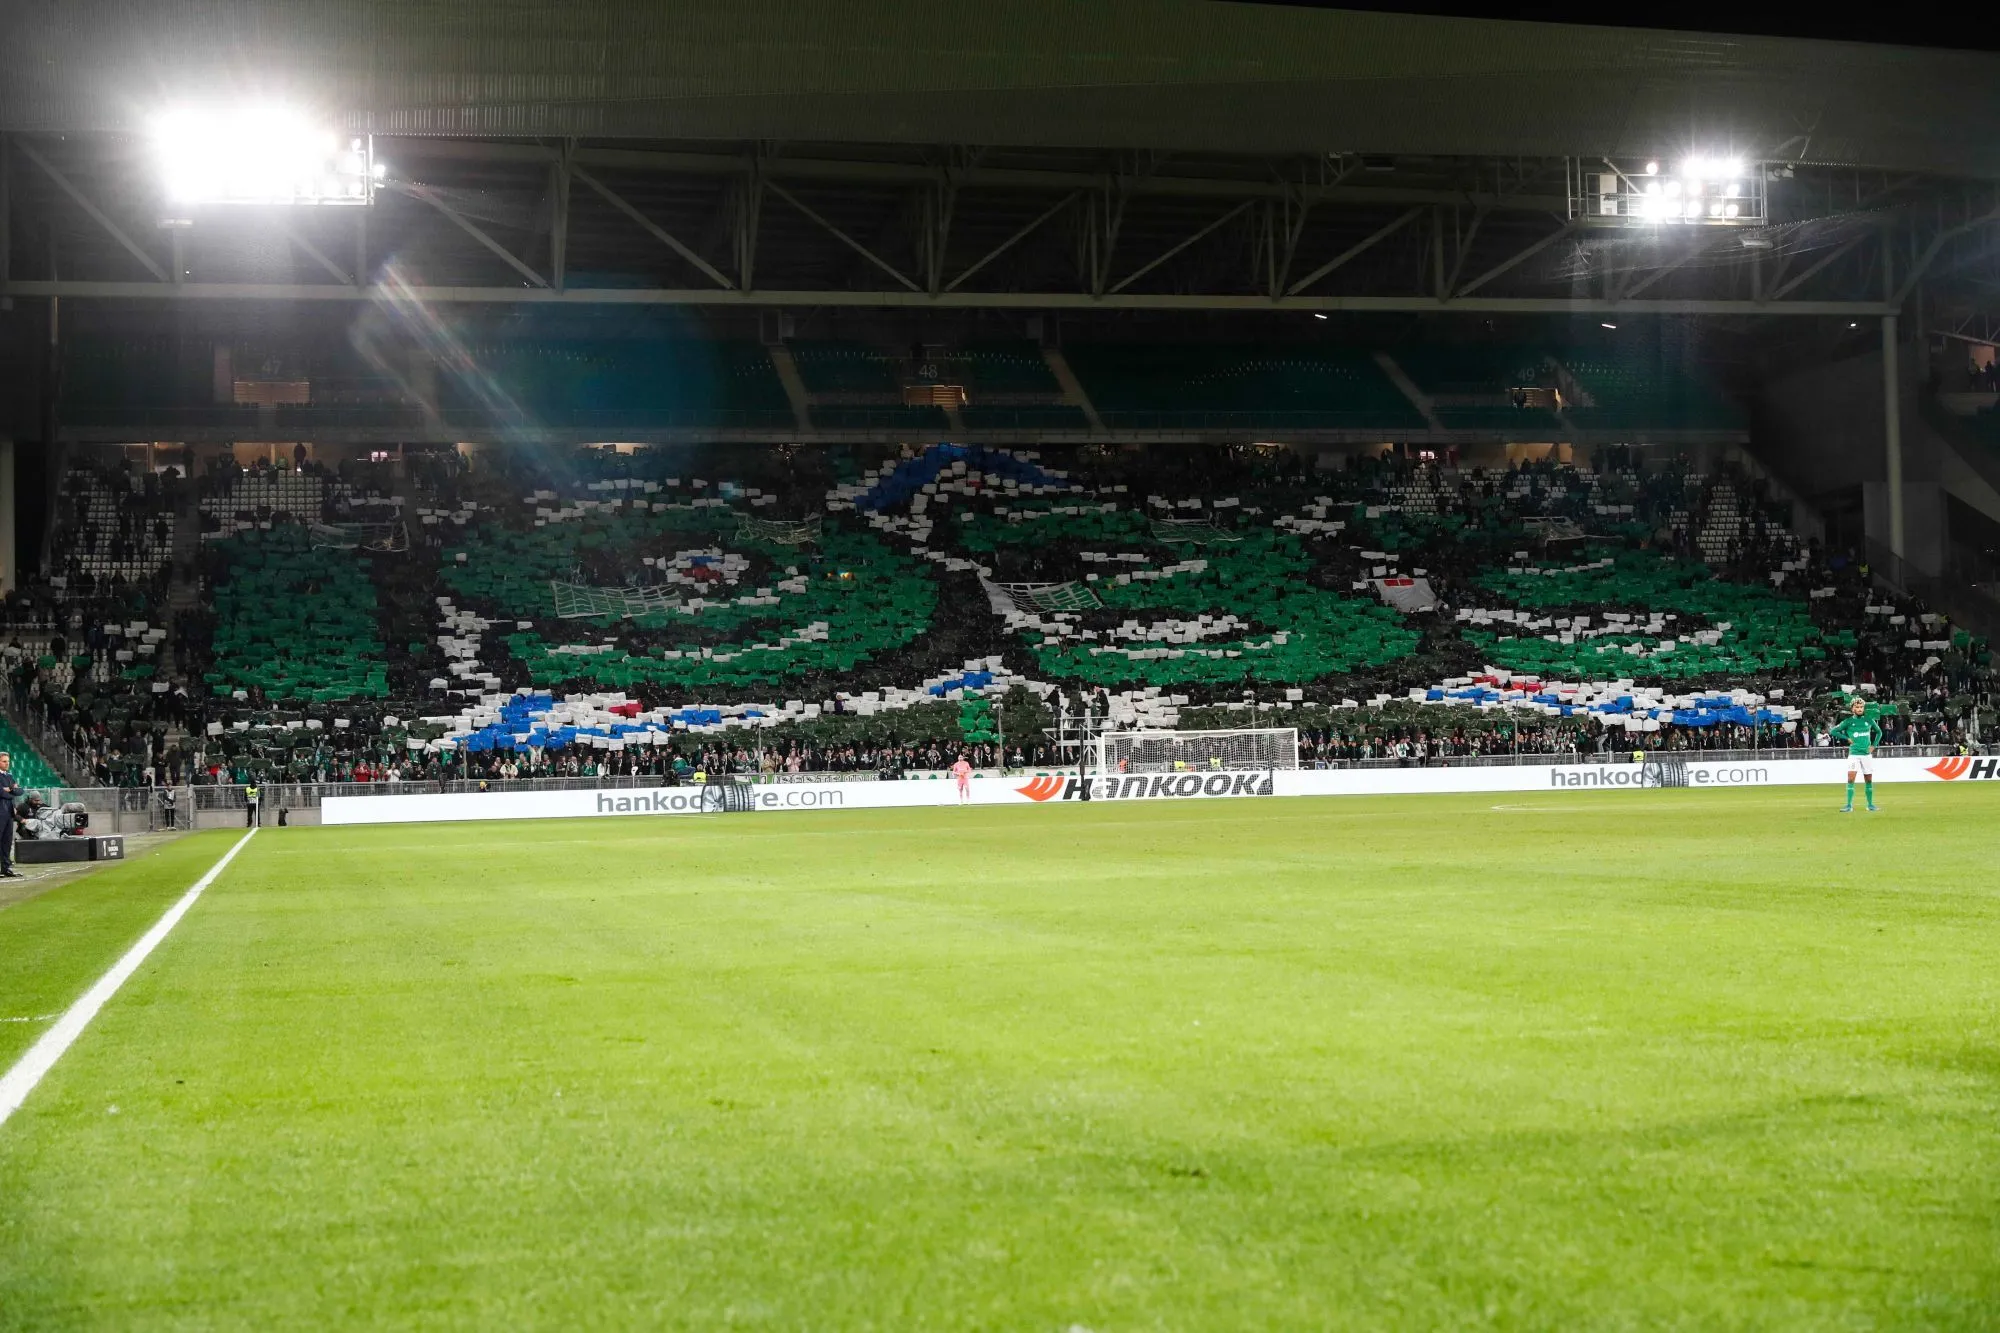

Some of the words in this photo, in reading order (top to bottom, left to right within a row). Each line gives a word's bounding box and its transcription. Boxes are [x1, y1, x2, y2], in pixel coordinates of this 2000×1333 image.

[919, 365, 938, 377] 48
[1516, 367, 1535, 382] 49
[1969, 759, 2000, 779] H
